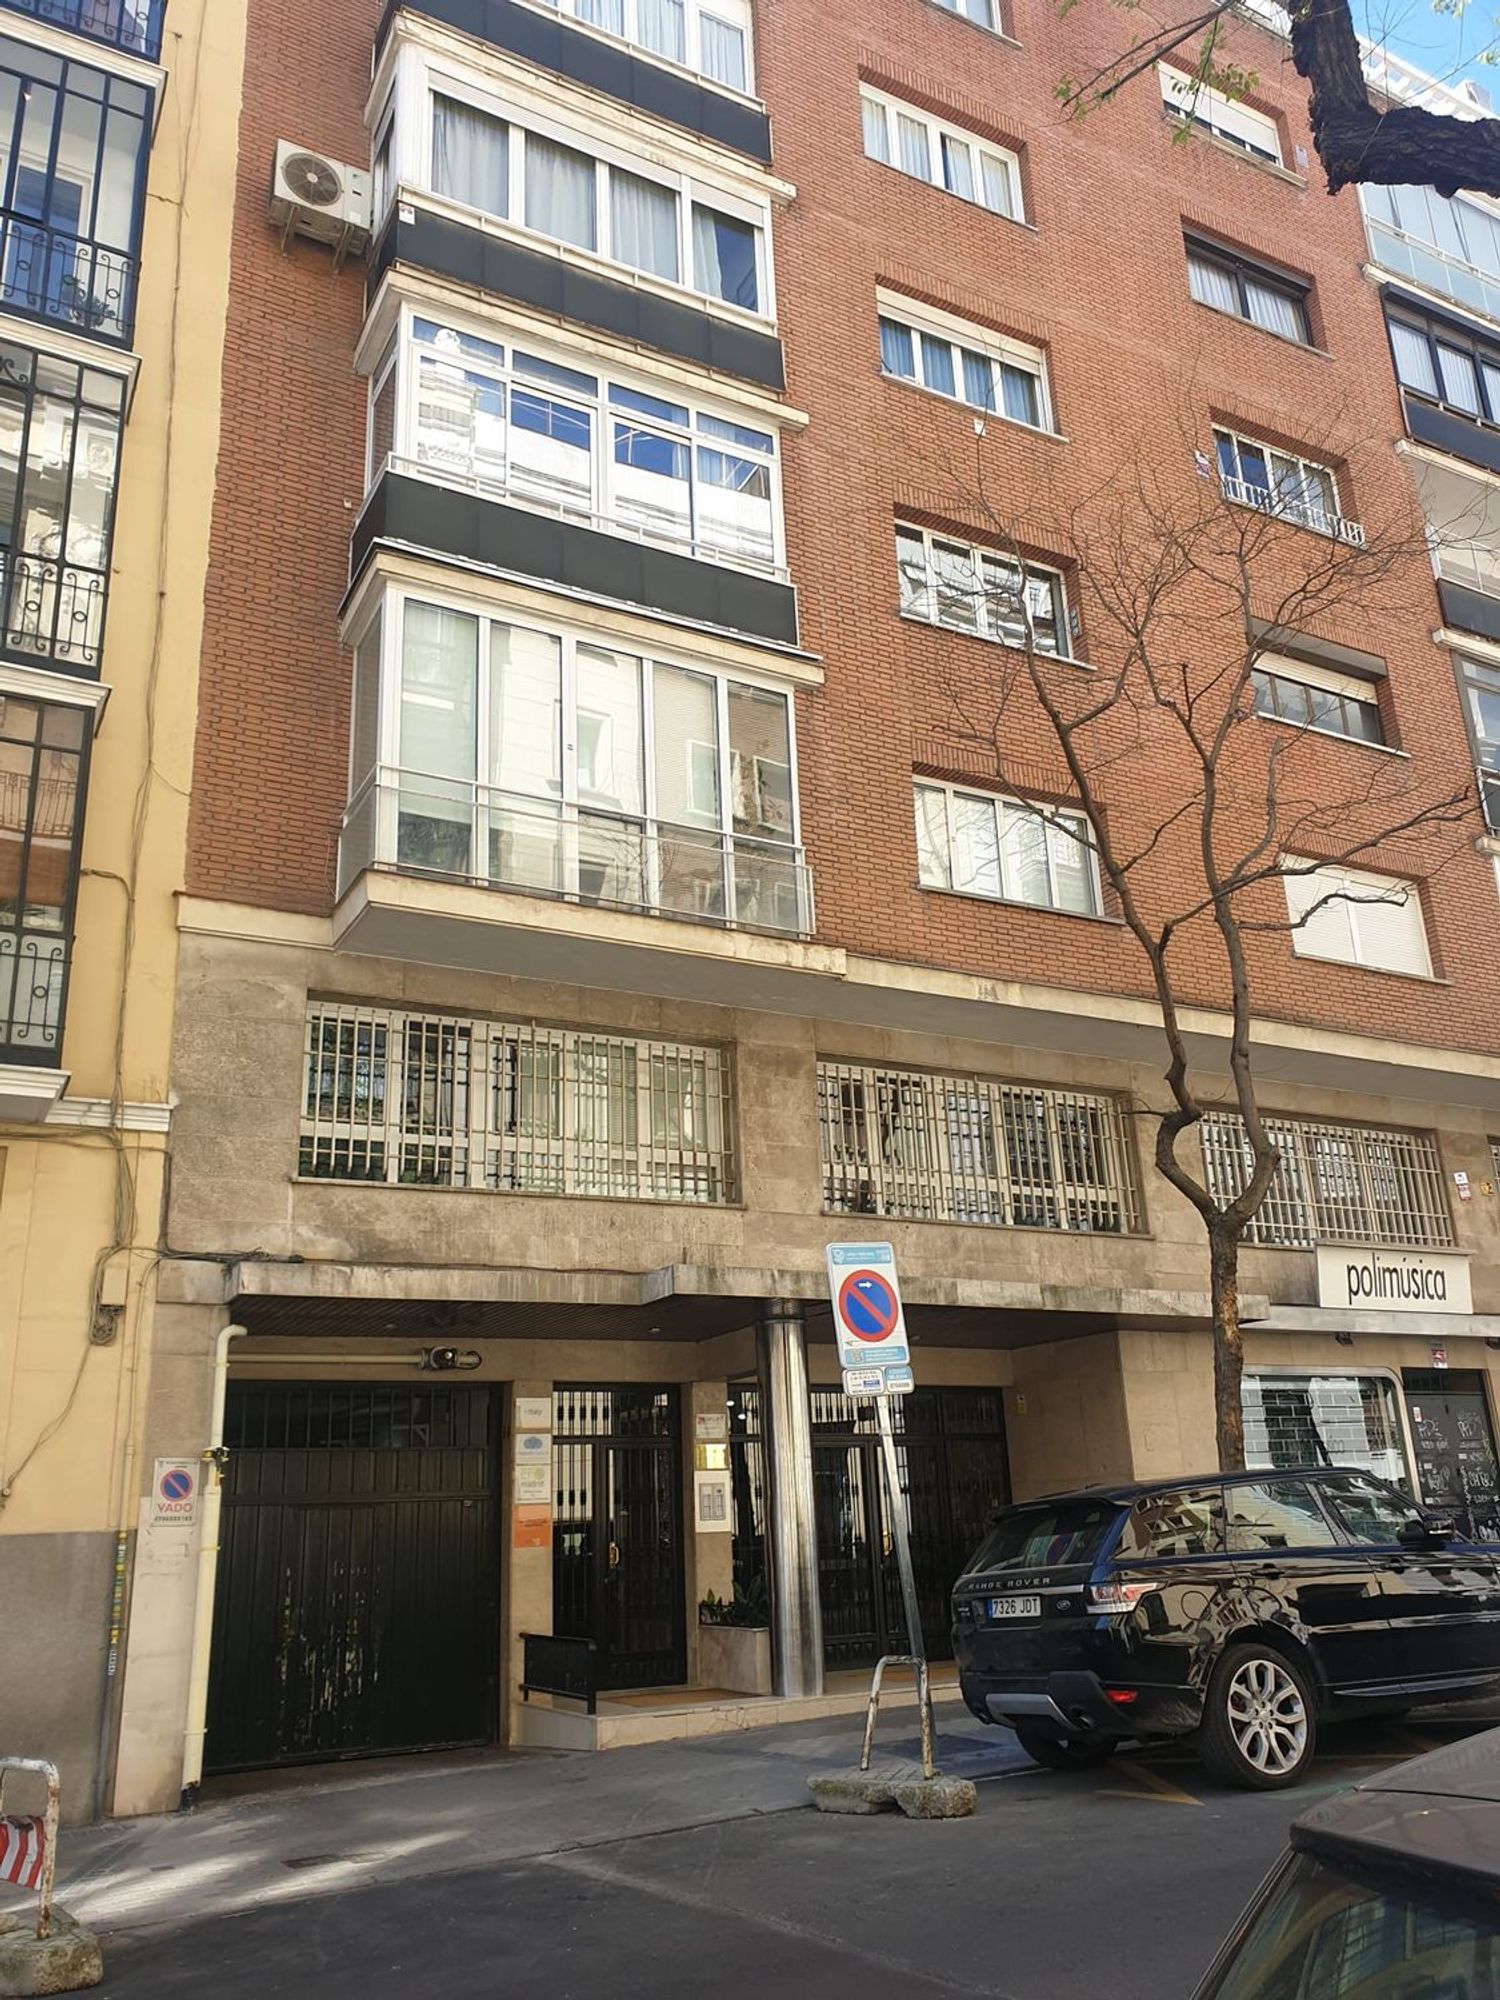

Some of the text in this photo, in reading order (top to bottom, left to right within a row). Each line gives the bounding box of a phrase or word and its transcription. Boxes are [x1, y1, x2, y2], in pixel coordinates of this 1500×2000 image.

[1346, 1251, 1447, 1306] polimúsica
[158, 1502, 193, 1513] VADO
[968, 1577, 1050, 1590] RANGE ROVER
[993, 1600, 1016, 1615] 7326
